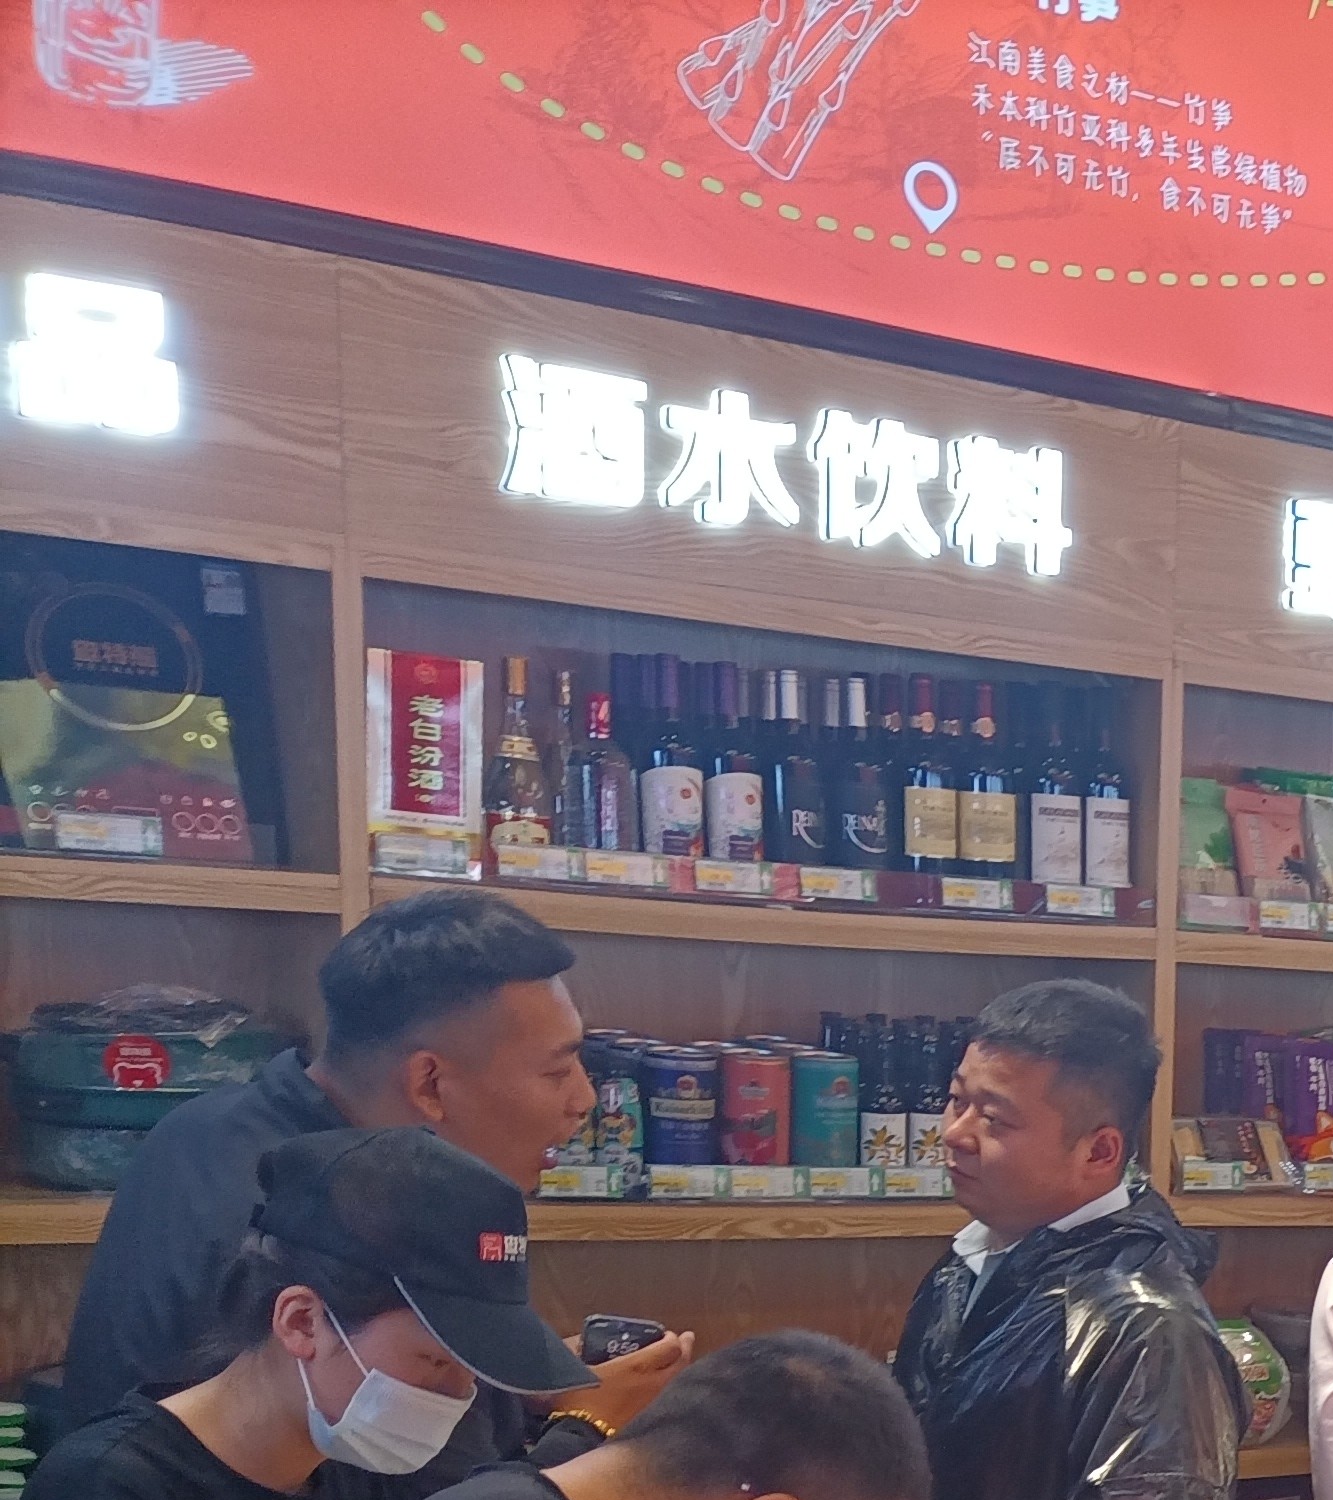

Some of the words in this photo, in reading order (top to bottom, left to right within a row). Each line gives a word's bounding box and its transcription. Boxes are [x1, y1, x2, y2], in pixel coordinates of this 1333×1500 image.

[498, 353, 1073, 577] 酒水饮料
[407, 694, 445, 792] 老白汾酒
